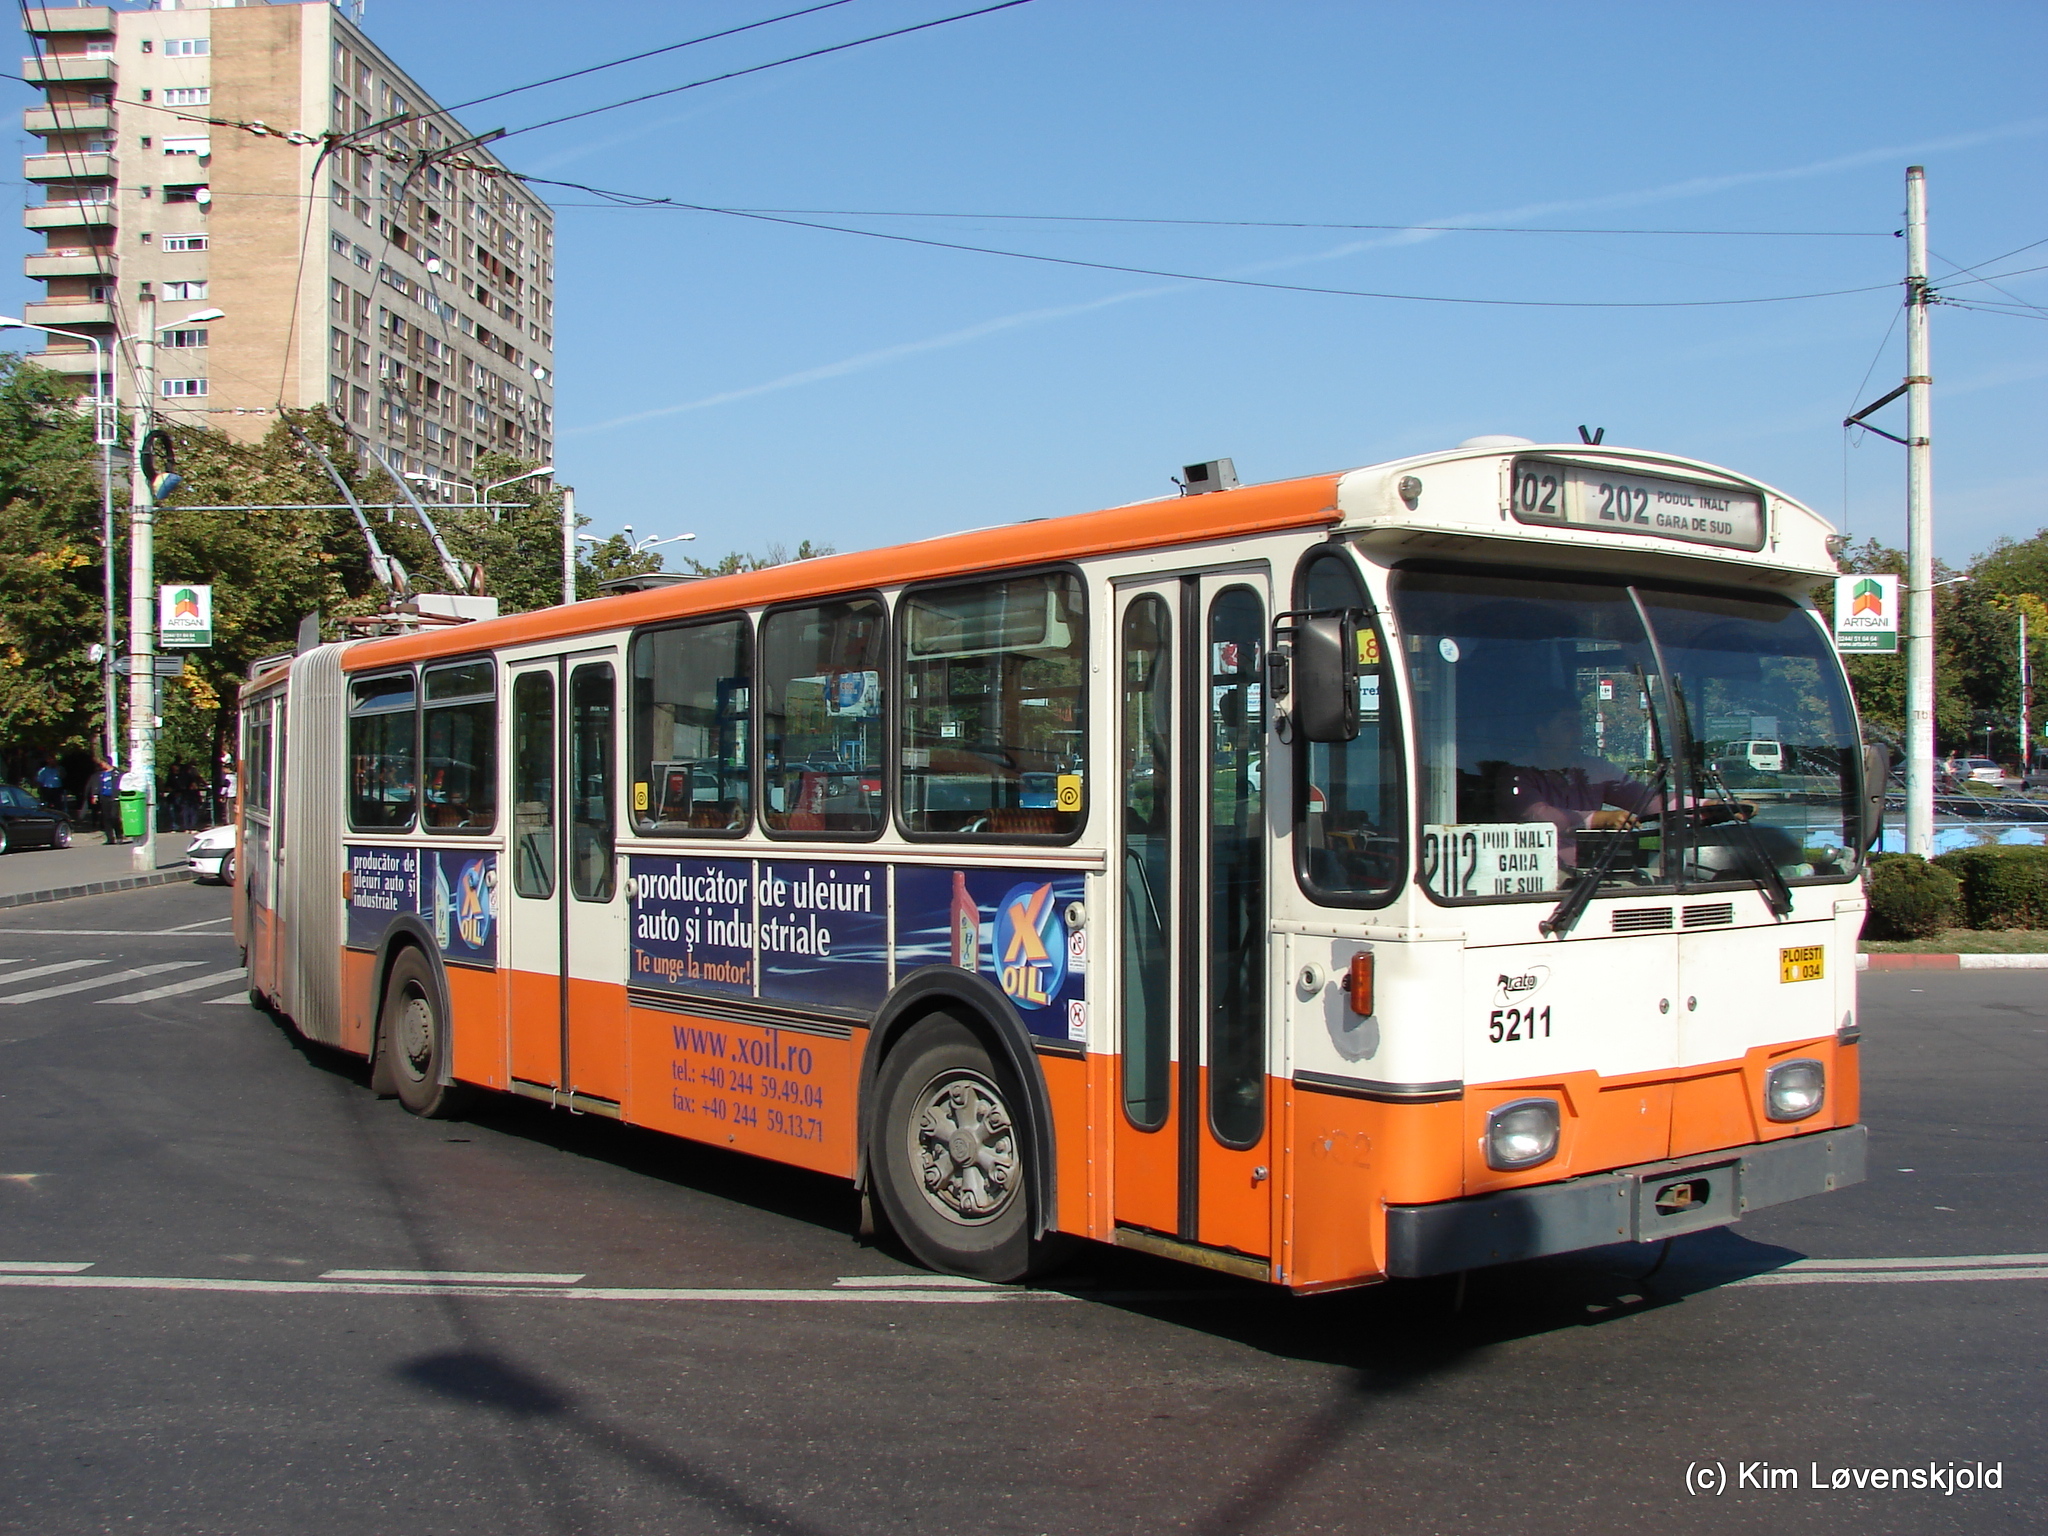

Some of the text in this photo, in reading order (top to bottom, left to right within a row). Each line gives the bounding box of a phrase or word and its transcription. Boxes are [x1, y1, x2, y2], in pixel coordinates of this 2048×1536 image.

[1599, 483, 1649, 525] 202
[1657, 490, 1694, 507] PODUL
[1656, 513, 1732, 535] GARA DE SUD
[168, 618, 204, 627] ARTSANI
[1844, 617, 1888, 627] ARTSANI
[353, 850, 415, 874] producător de
[1424, 832, 1477, 897] 202
[1482, 831, 1509, 849] POD
[1499, 853, 1539, 872] GARA
[354, 869, 381, 890] uleiuri
[384, 874, 404, 892] auto
[637, 863, 871, 912] producător de uleiuri
[1494, 876, 1543, 895] DE SUD
[353, 888, 398, 911] industriale
[461, 918, 485, 946] OIL
[638, 907, 680, 942] auto
[707, 906, 831, 956] industriale
[1004, 882, 1055, 966] X
[635, 949, 751, 985] Te unge la motor!
[1783, 947, 1821, 963] PLOIESTI
[1003, 966, 1051, 1006] OIL
[1784, 964, 1820, 980] 1 034
[1489, 1005, 1550, 1043] 5211
[673, 1025, 813, 1075] www.xoil.ro
[672, 1059, 823, 1109] tel.: +40 244 59.49.04
[672, 1087, 823, 1143] fax: +40 244 59.13.71
